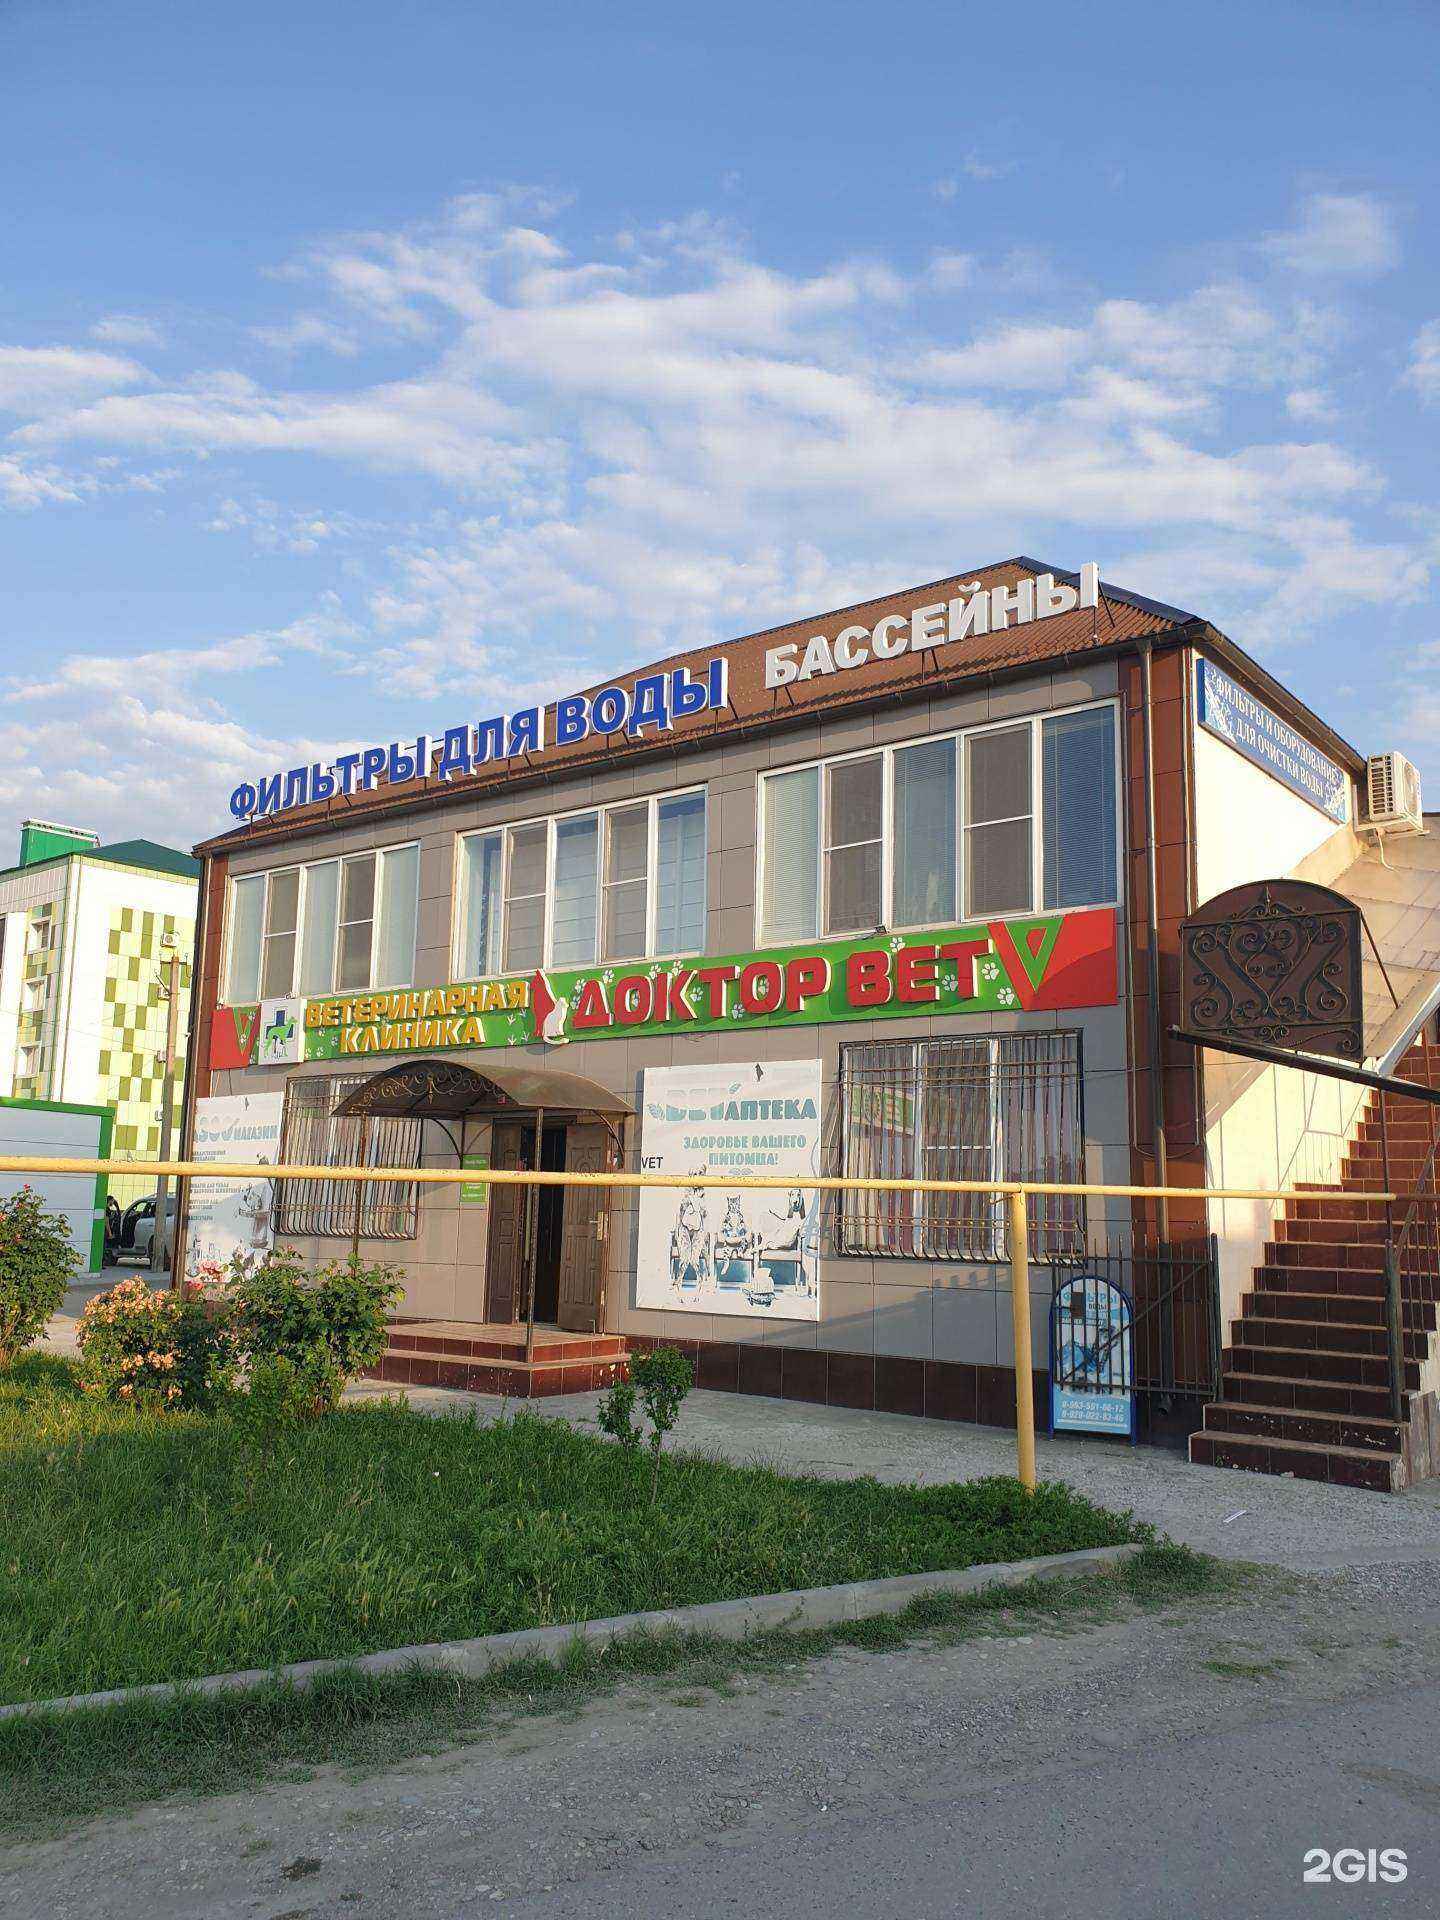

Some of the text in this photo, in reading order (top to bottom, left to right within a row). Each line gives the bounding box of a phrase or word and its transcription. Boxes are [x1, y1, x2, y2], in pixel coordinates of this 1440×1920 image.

[764, 562, 1099, 690] БАССЕЙНЫ
[229, 658, 728, 821] ФИЛЬТРЫ ДЛЯ ВОДЫ
[1217, 677, 1338, 784] ФИЛЬТРЫ И ОБОРУДОВАНИЕ
[1236, 718, 1324, 798] ДЛЯ ОЧИСТКИ ВОДЫ
[306, 981, 530, 1028] ВЕТЕРИНАРНАЯ
[571, 939, 995, 1029] ДОКТОР ВЕТ
[339, 1017, 487, 1053] КЛИНИКА
[641, 1156, 664, 1169] VET
[683, 1135, 807, 1149] ЗДОРОВЬЕ ВАШЕГО
